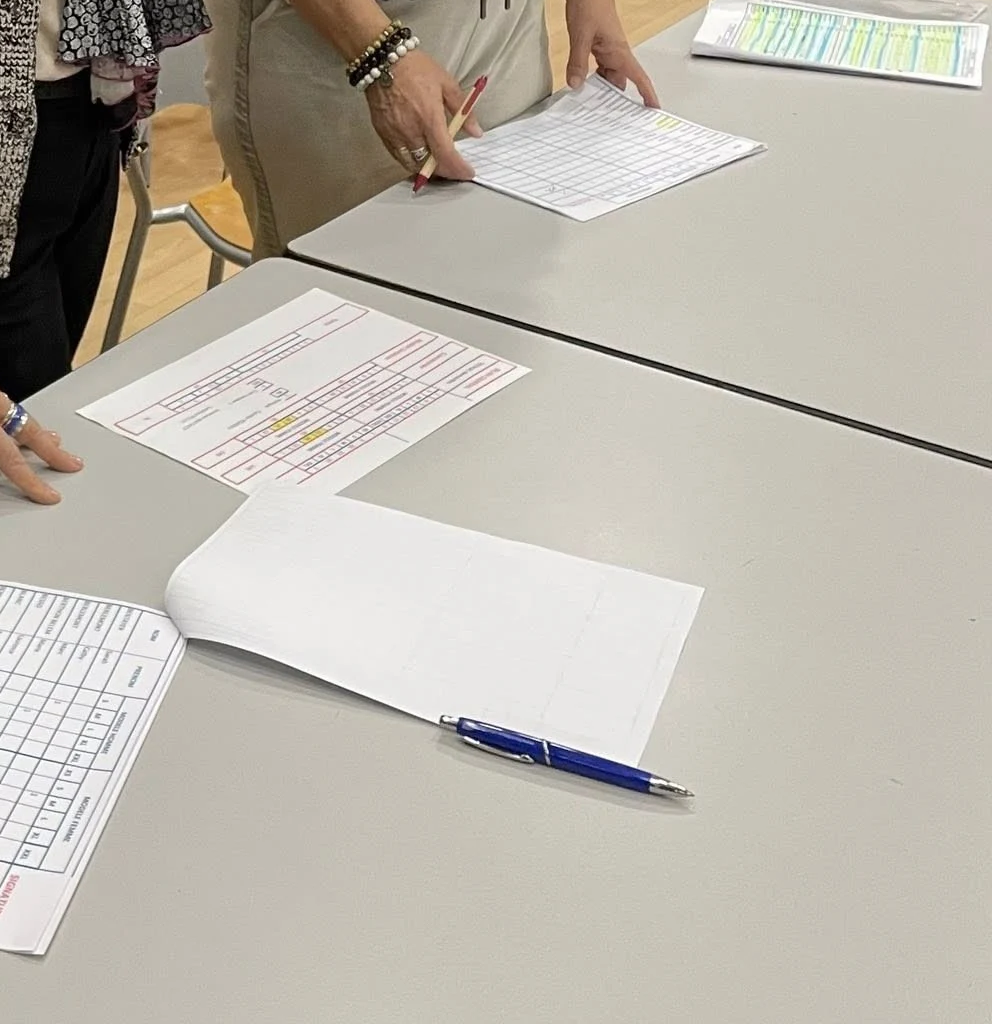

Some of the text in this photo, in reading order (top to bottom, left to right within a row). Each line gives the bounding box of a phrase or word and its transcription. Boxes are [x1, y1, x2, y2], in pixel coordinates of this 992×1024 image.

[149, 629, 159, 641] NOM
[127, 665, 142, 687] PRENOM
[101, 711, 127, 754] MODELE HOMME
[63, 796, 91, 843] MODELE FEMME
